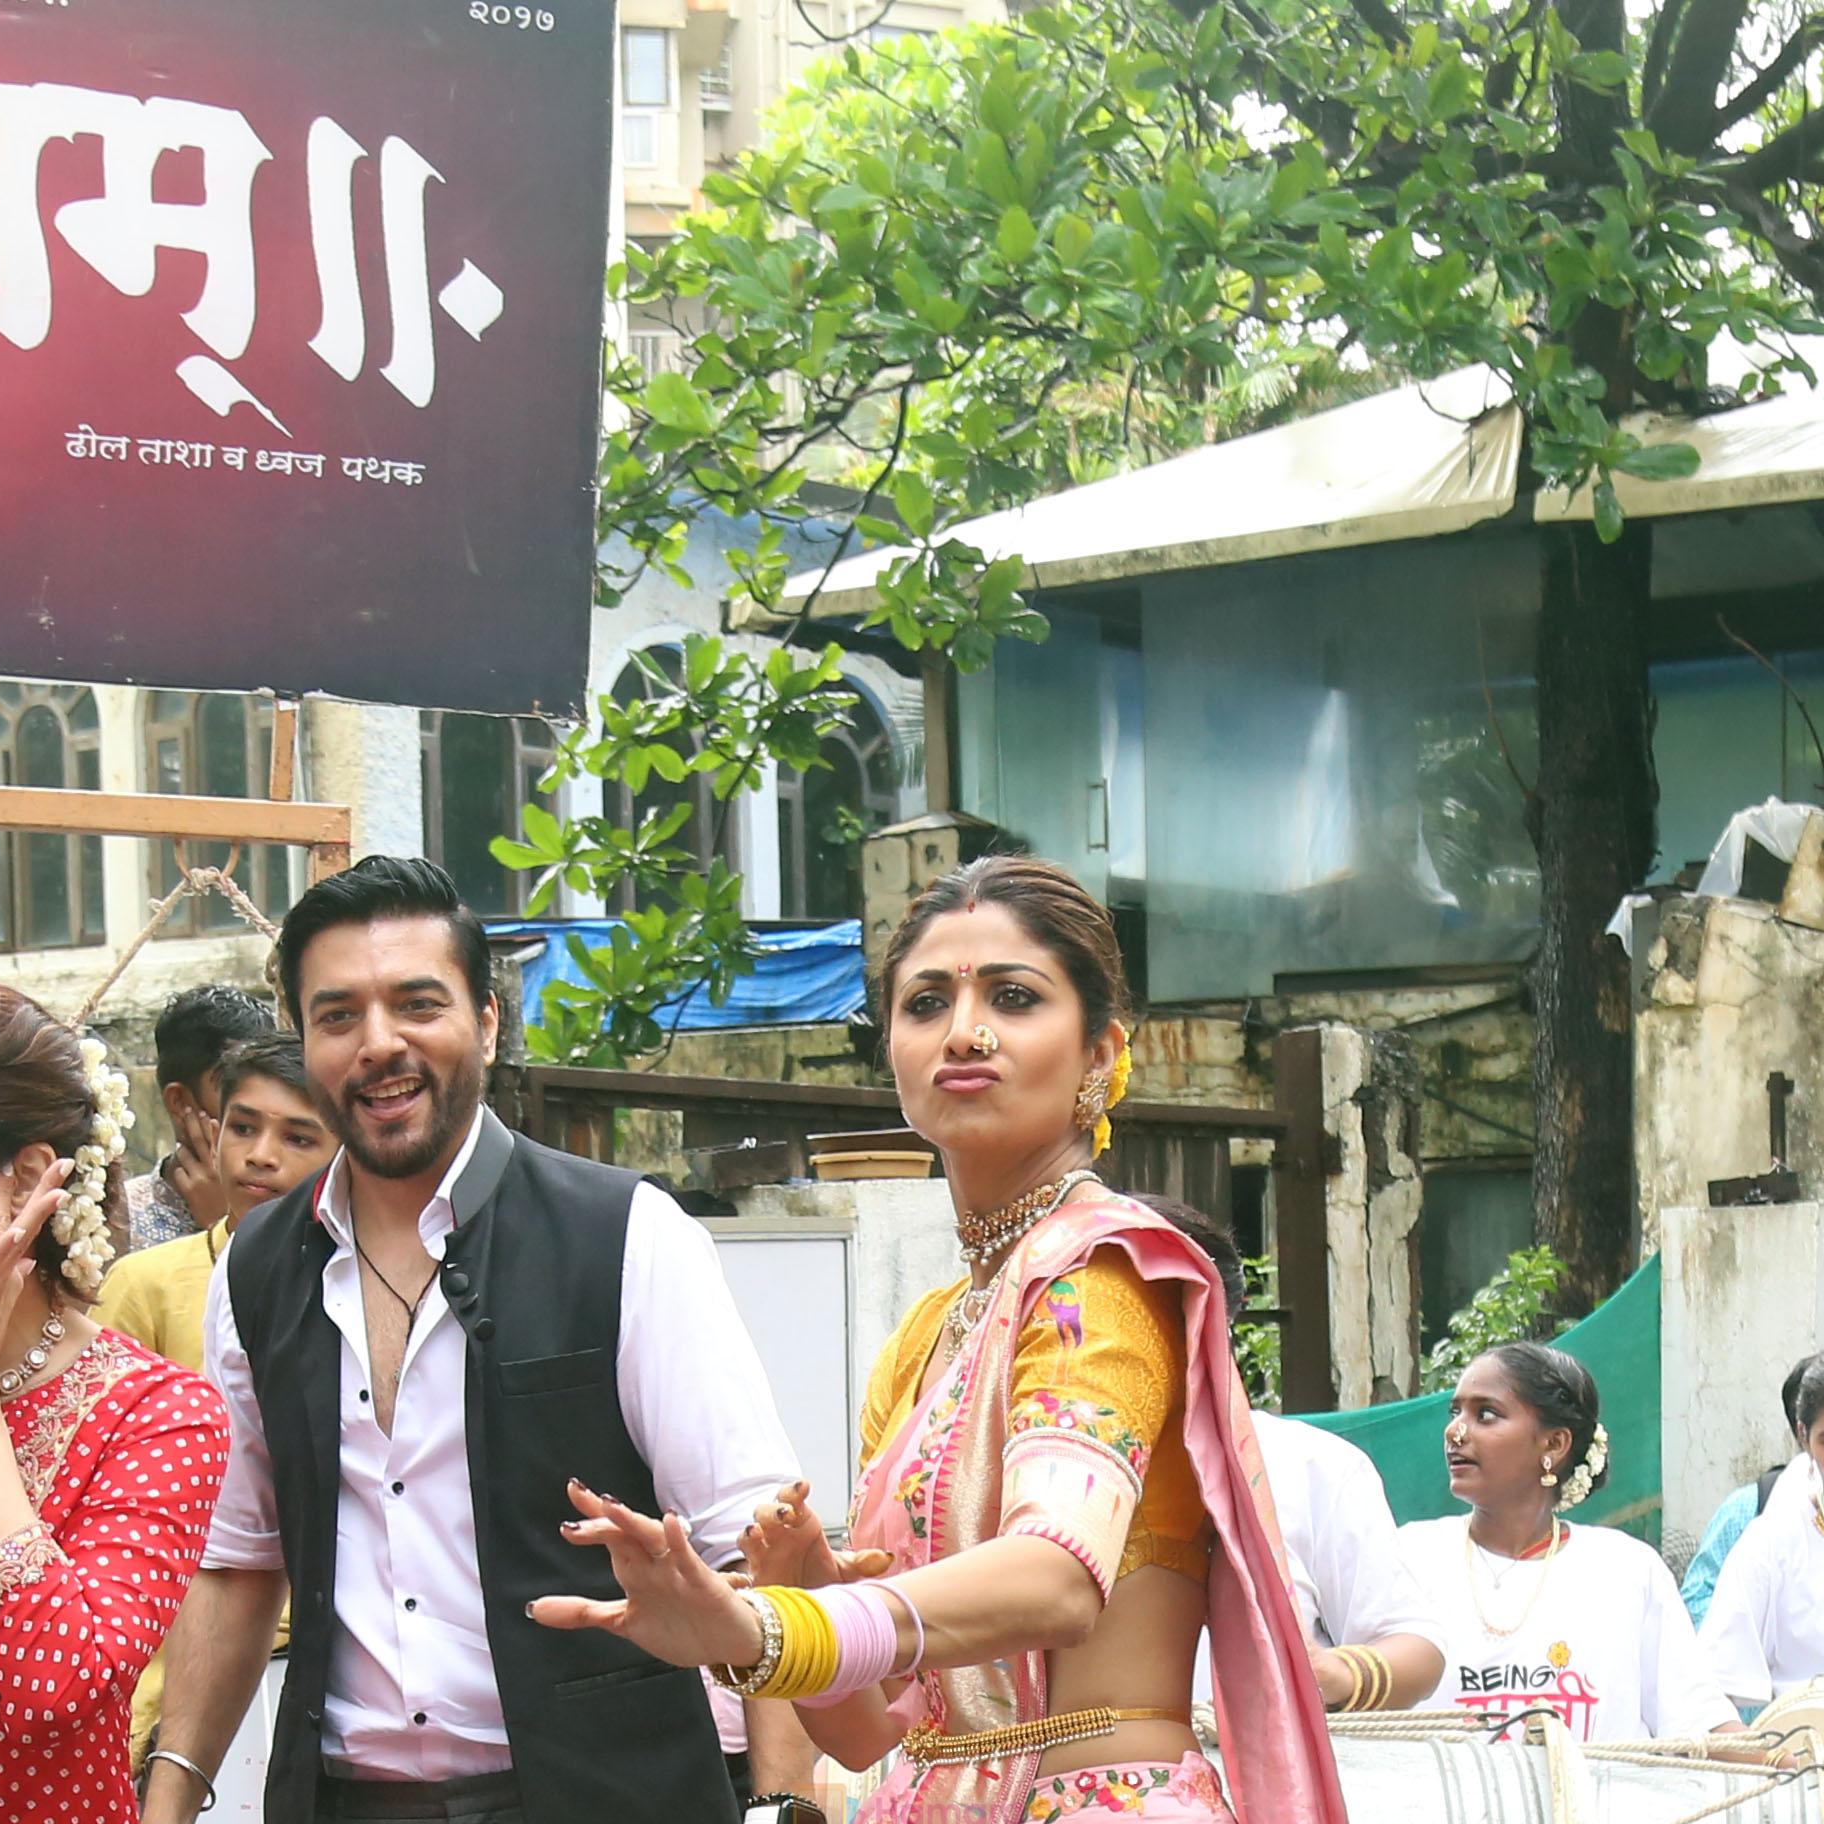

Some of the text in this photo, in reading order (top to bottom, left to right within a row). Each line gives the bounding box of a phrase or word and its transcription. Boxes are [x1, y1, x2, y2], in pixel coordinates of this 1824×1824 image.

[469, 0, 555, 31] २०१७
[64, 423, 426, 486] ढोल ताशा व ध्वज पथक
